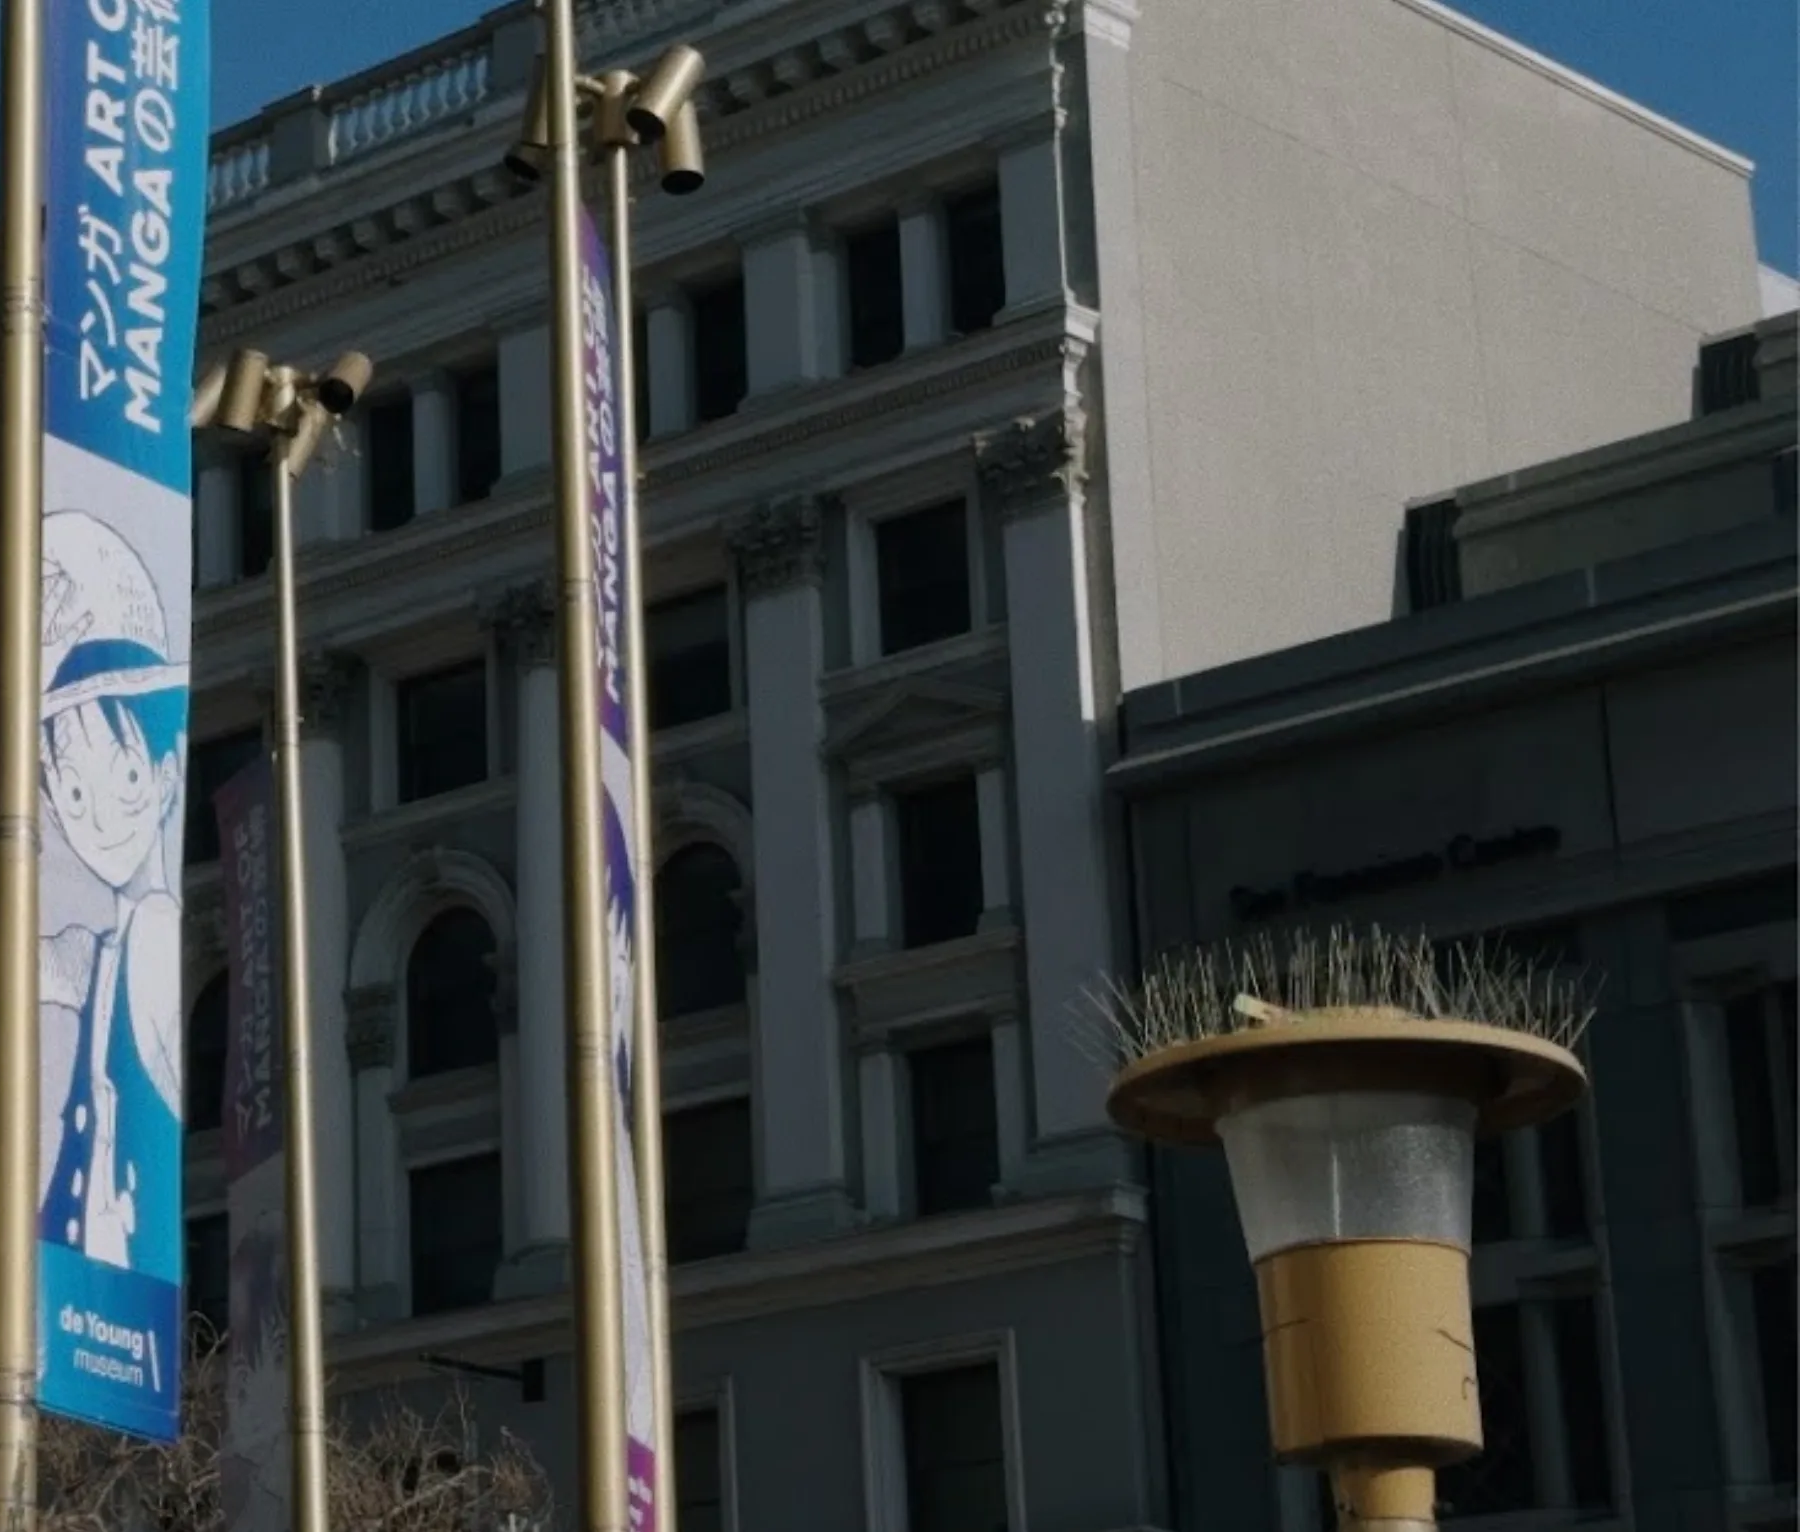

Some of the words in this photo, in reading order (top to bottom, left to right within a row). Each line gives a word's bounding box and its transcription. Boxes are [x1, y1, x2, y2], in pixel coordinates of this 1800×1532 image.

[85, 41, 126, 197] ART
[77, 203, 121, 400] マンガ
[59, 1304, 83, 1334] de
[85, 1311, 143, 1360] Young
[73, 1348, 143, 1388] museum
